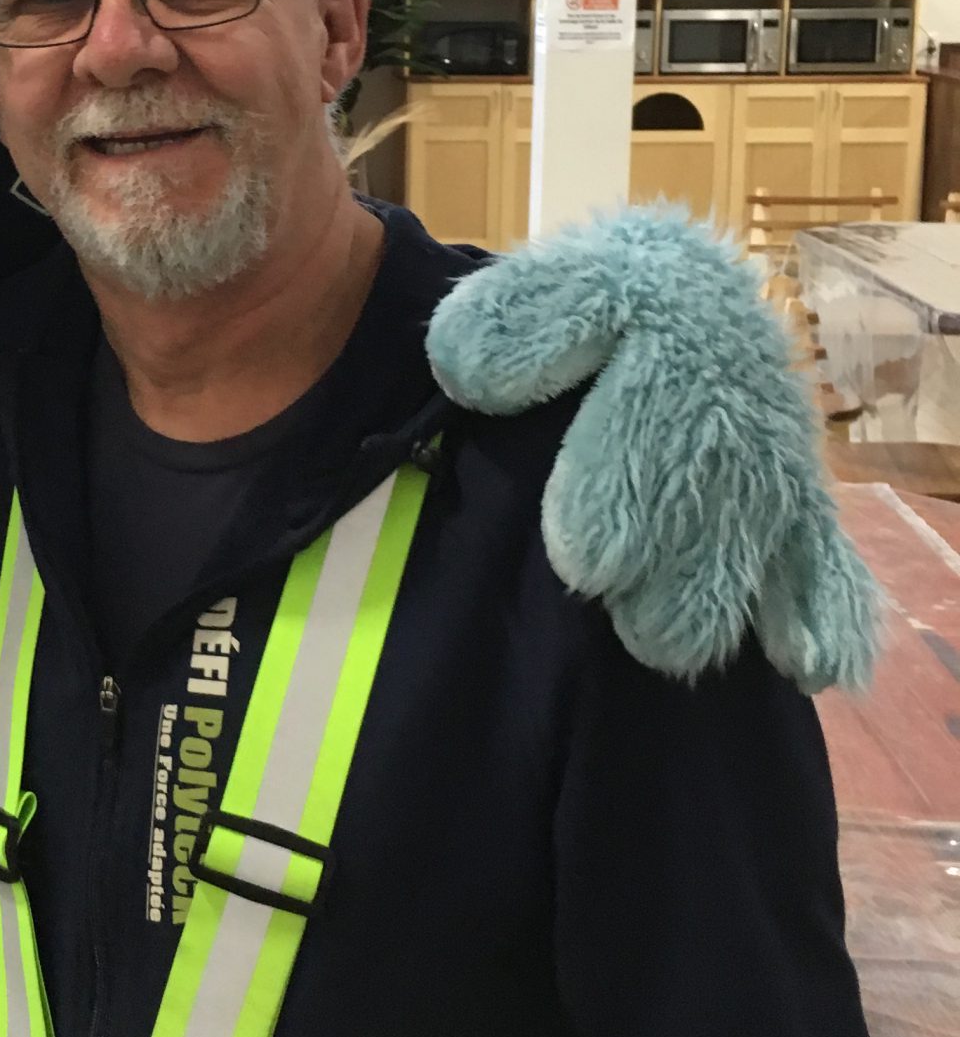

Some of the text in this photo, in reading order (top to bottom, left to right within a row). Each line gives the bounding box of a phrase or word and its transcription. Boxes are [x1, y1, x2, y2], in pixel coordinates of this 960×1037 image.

[148, 704, 178, 923] Une Force adaptée
